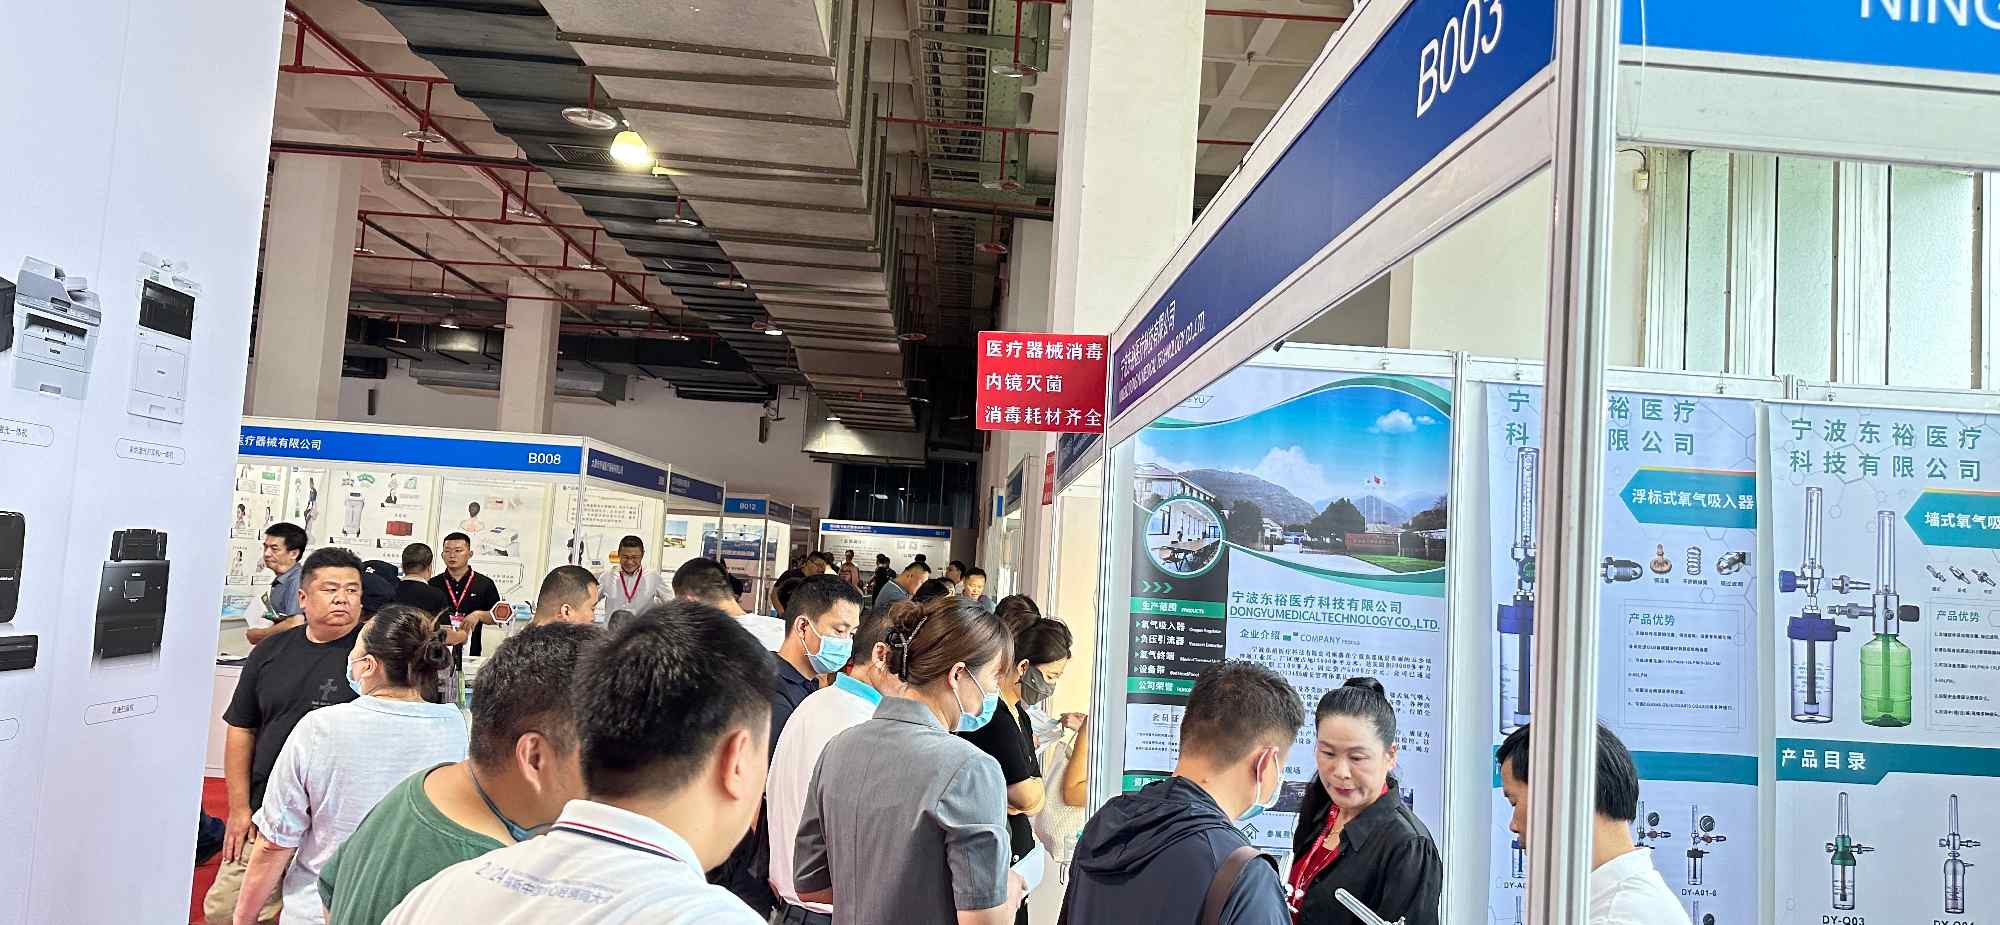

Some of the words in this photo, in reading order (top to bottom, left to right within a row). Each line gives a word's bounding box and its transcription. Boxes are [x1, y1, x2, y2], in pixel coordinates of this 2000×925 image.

[1416, 0, 1503, 119] B003
[985, 340, 1104, 361] 医疗器械消毒
[985, 372, 1064, 393] 内镜灭菌
[984, 406, 1104, 426] 消毒耗材齐全
[1790, 417, 1983, 450] 宁波东裕医疗
[528, 452, 561, 465] B008
[1789, 449, 1982, 482] 科技有限公司
[1631, 487, 1756, 511] 浮标式氧气吸入器
[1231, 590, 1402, 615] 宁波东裕医疗科技有限公司
[1628, 612, 1676, 626] 产品优势
[1936, 609, 1981, 623] 产品优势
[1140, 634, 1185, 646] 负压引流器
[1240, 628, 1281, 642] 企业介绍
[1300, 634, 1341, 645] COMPANY
[1780, 747, 1867, 771] 产品目录
